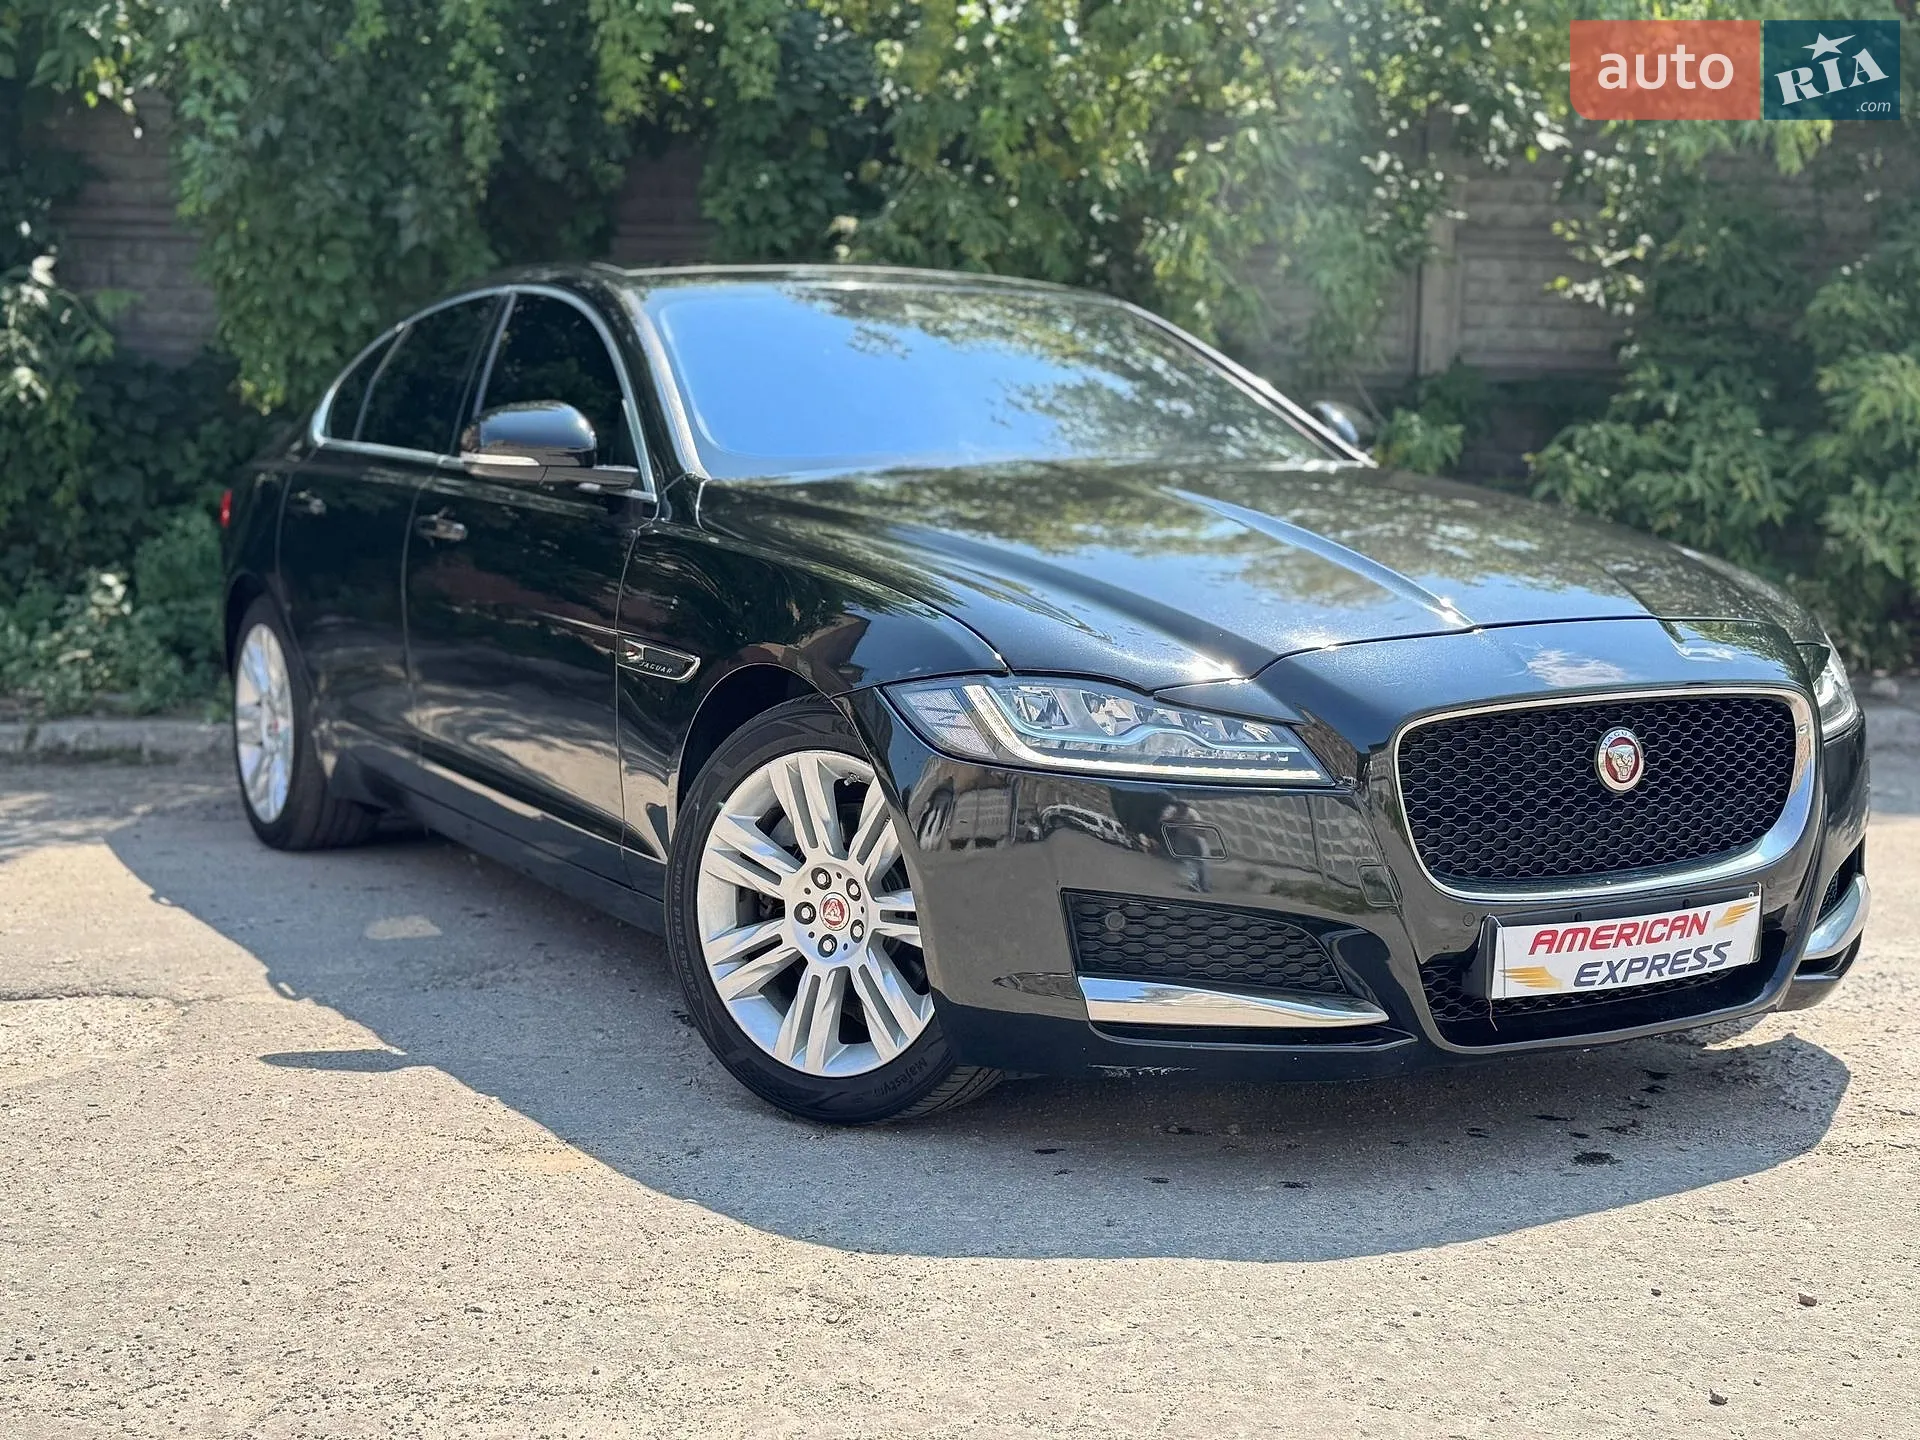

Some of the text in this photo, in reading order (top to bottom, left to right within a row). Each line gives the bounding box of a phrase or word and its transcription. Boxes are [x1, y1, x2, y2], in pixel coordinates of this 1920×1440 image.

[640, 661, 673, 674] JAGUAR
[1528, 911, 1711, 955] AMERICAN
[1573, 940, 1732, 988] EXPRESS
